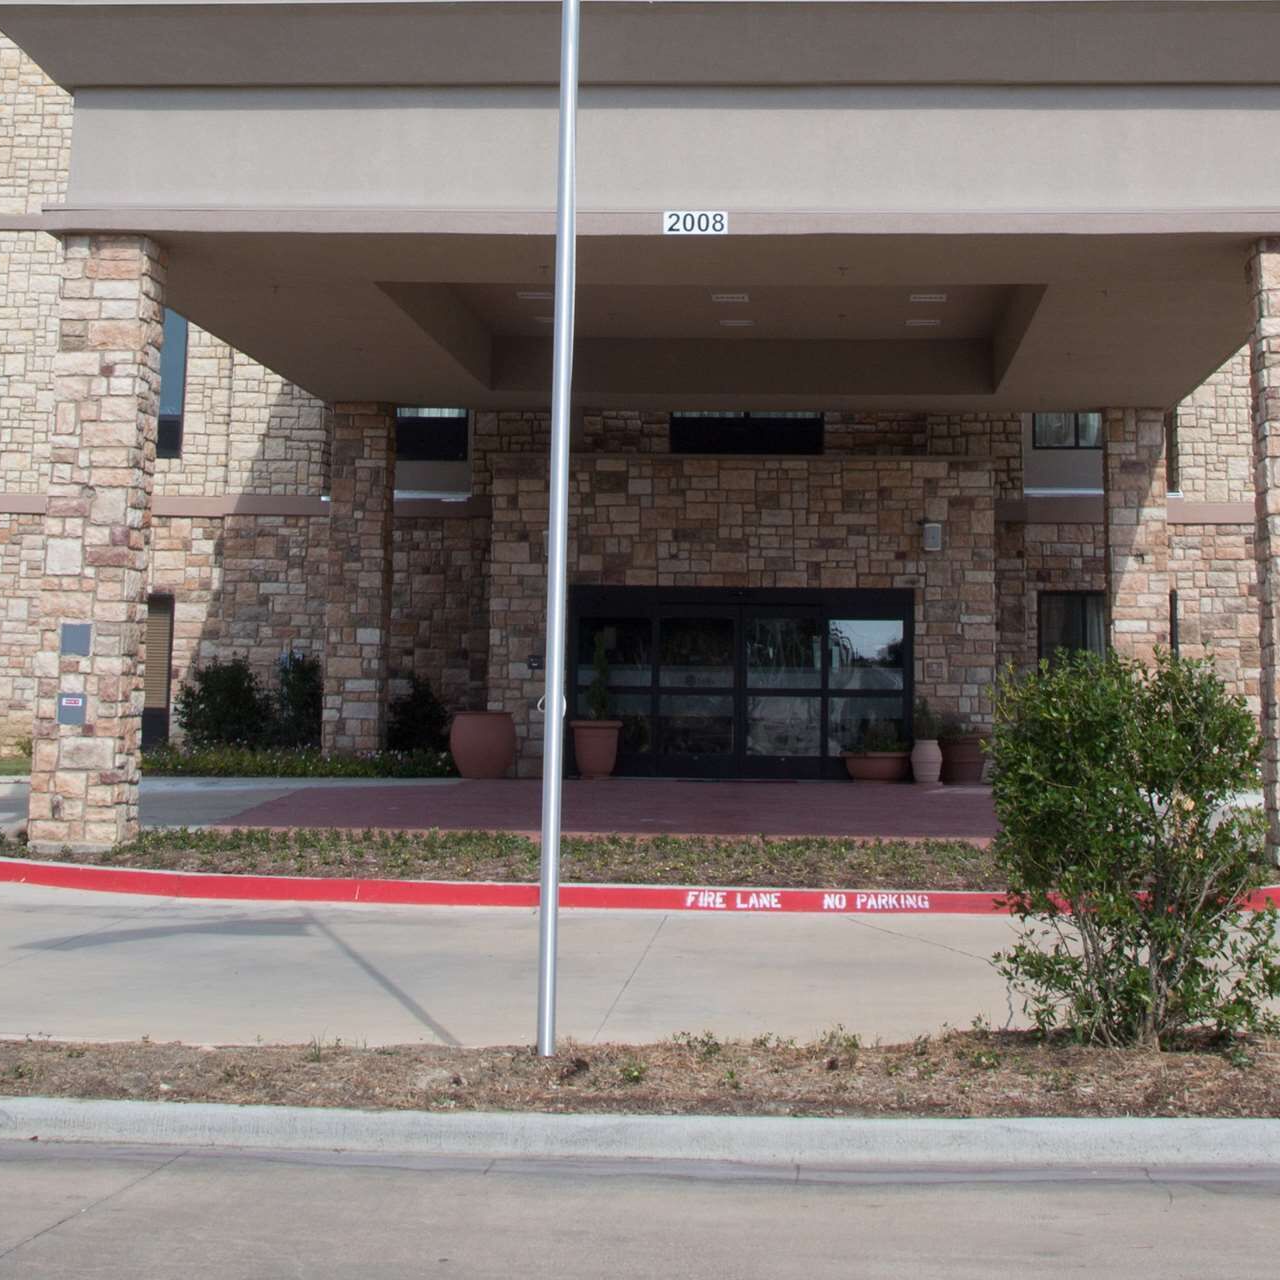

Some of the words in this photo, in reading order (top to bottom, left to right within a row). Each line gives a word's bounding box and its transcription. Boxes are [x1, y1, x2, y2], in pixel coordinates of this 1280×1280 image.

[668, 213, 724, 232] 2008
[686, 890, 726, 908] FIRE
[736, 892, 782, 908] LANE
[823, 893, 846, 909] NO
[856, 893, 929, 909] PARKING
